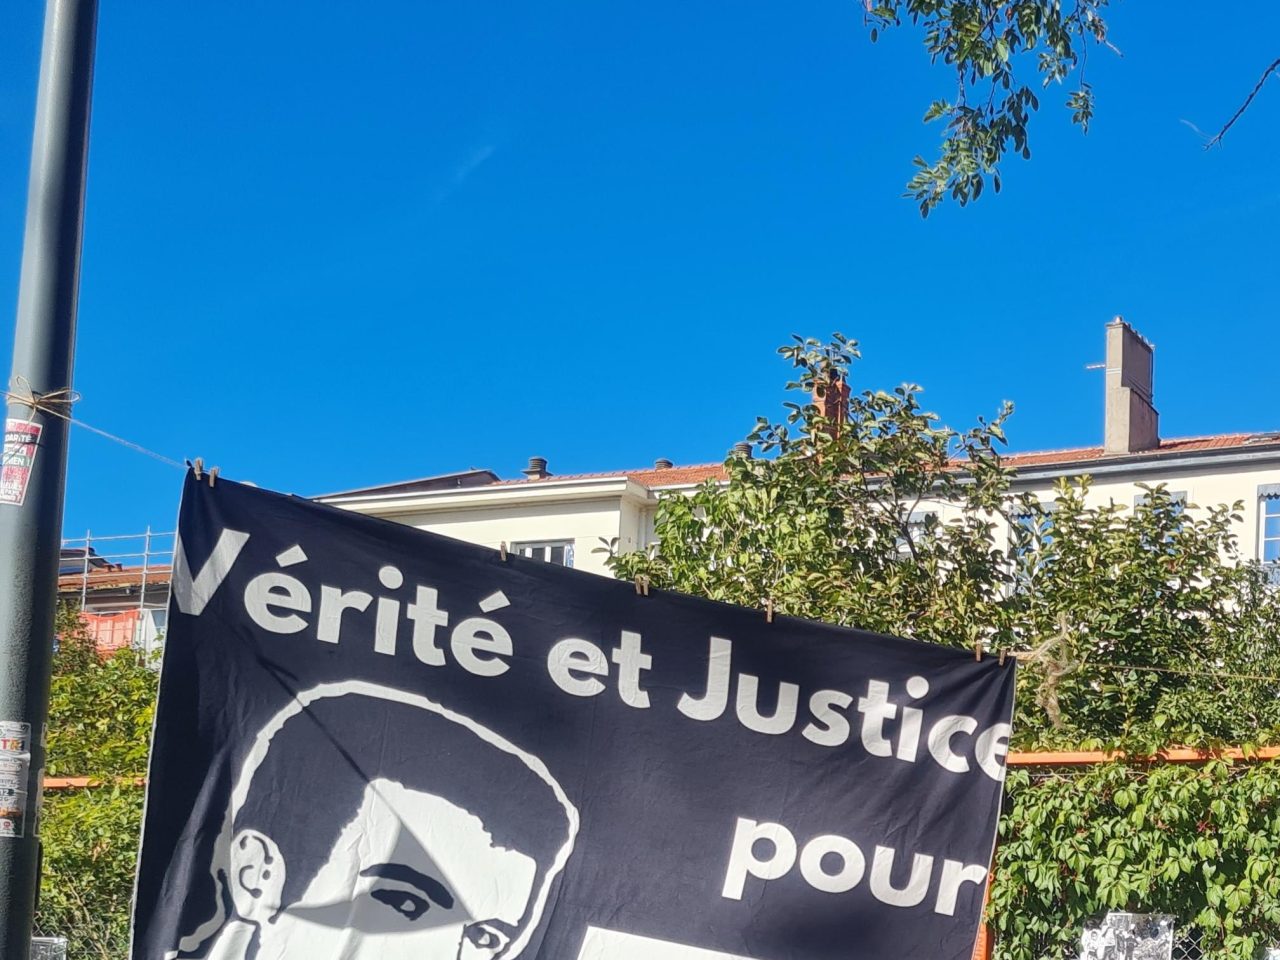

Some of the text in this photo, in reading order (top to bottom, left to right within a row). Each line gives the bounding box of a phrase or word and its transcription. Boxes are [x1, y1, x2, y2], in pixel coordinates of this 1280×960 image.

[172, 528, 1011, 782] Vérité et Justice
[722, 817, 988, 916] pour
